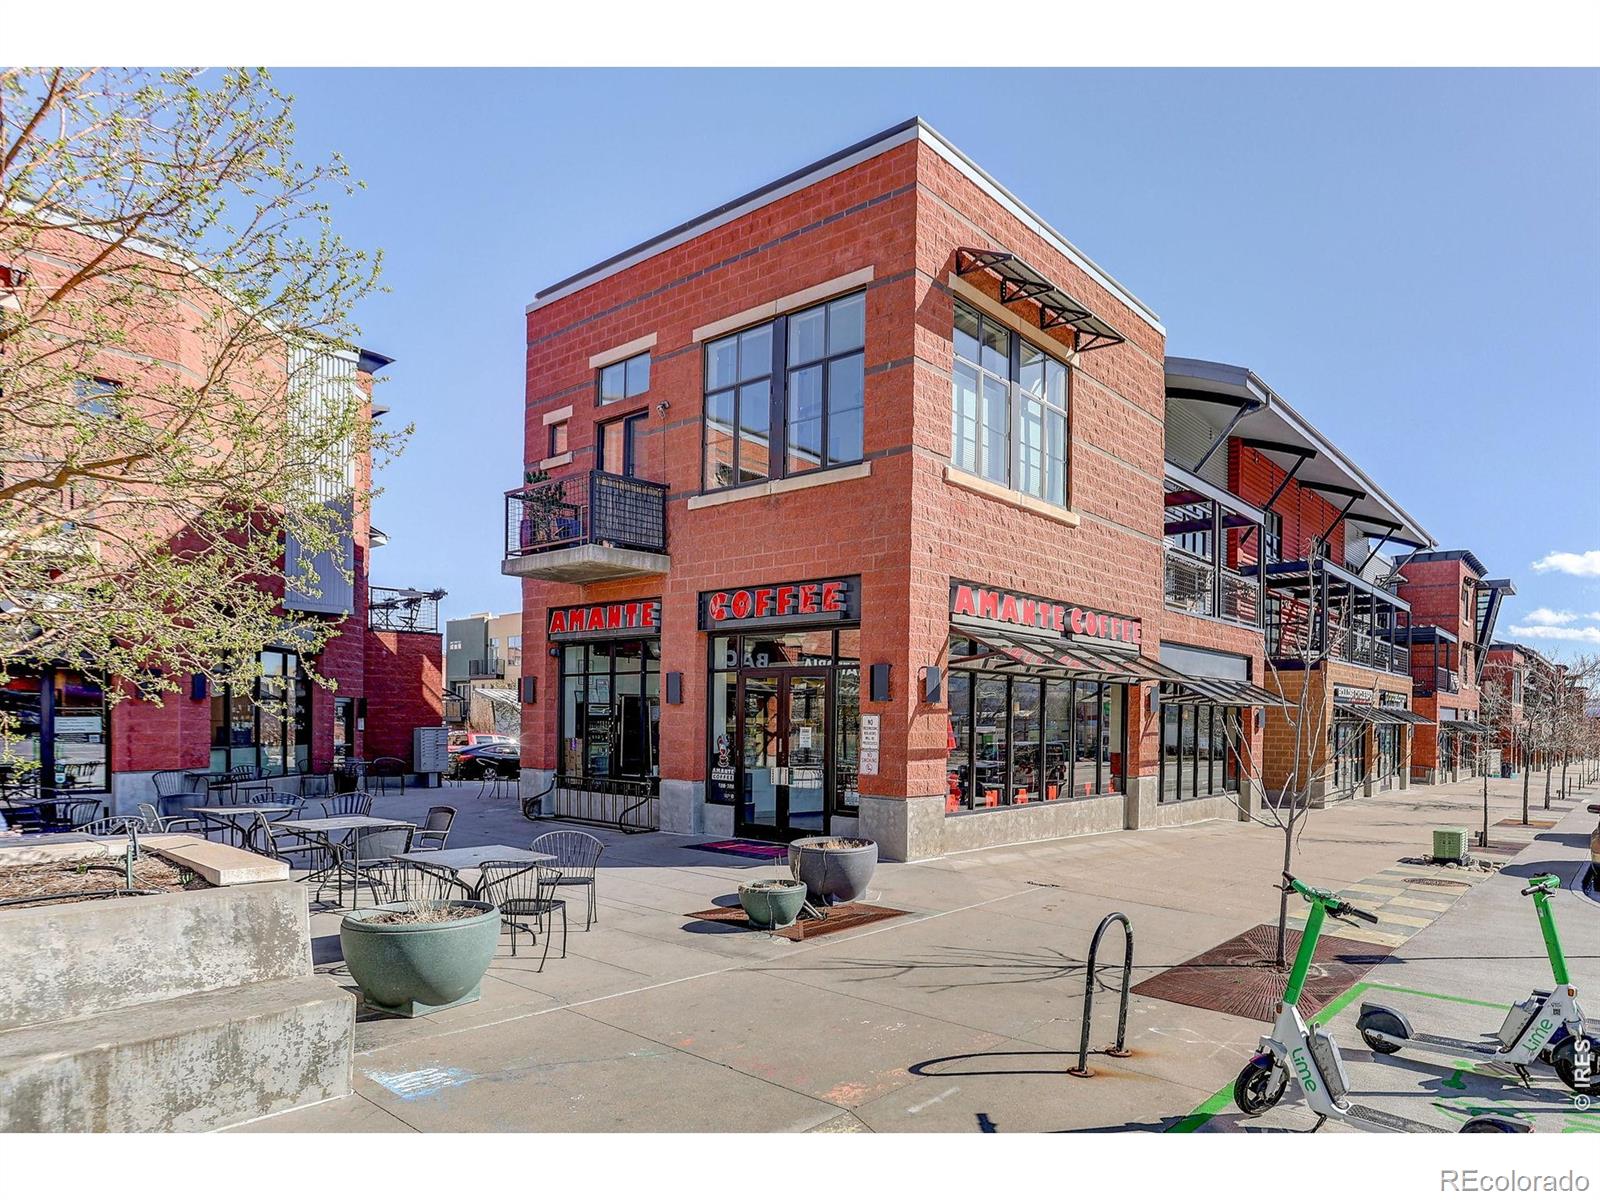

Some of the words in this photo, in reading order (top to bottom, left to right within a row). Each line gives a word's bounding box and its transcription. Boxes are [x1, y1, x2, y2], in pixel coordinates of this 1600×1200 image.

[549, 602, 657, 633] AMANTE
[709, 582, 844, 621] COFFEE
[953, 585, 1064, 632] AMANTE
[1068, 607, 1142, 645] COFFEE
[1522, 1018, 1553, 1051] Lime
[1292, 1047, 1317, 1092] Lime
